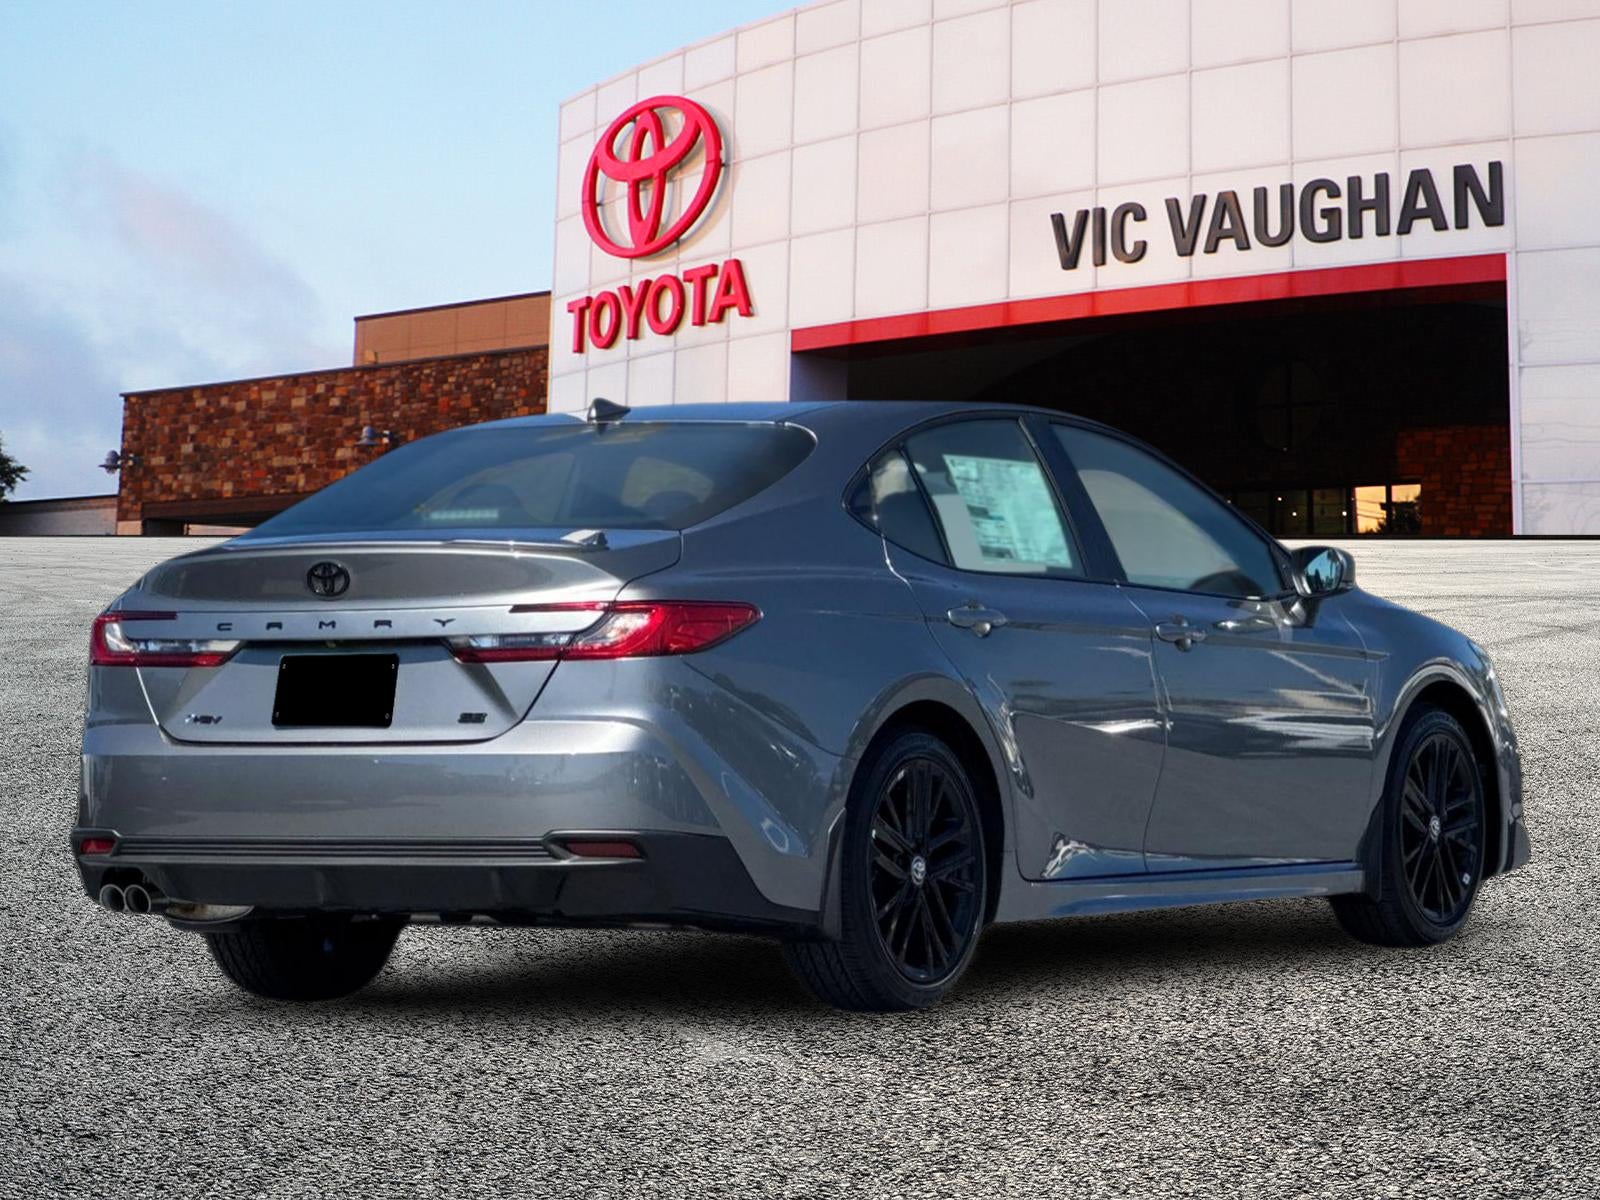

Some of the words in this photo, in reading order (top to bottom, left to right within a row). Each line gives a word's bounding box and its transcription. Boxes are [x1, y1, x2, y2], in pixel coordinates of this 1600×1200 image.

[1051, 201, 1148, 271] VIC
[1165, 161, 1505, 258] VAUGHAN
[567, 258, 754, 354] TOYOTA
[217, 617, 456, 632] CAMRY
